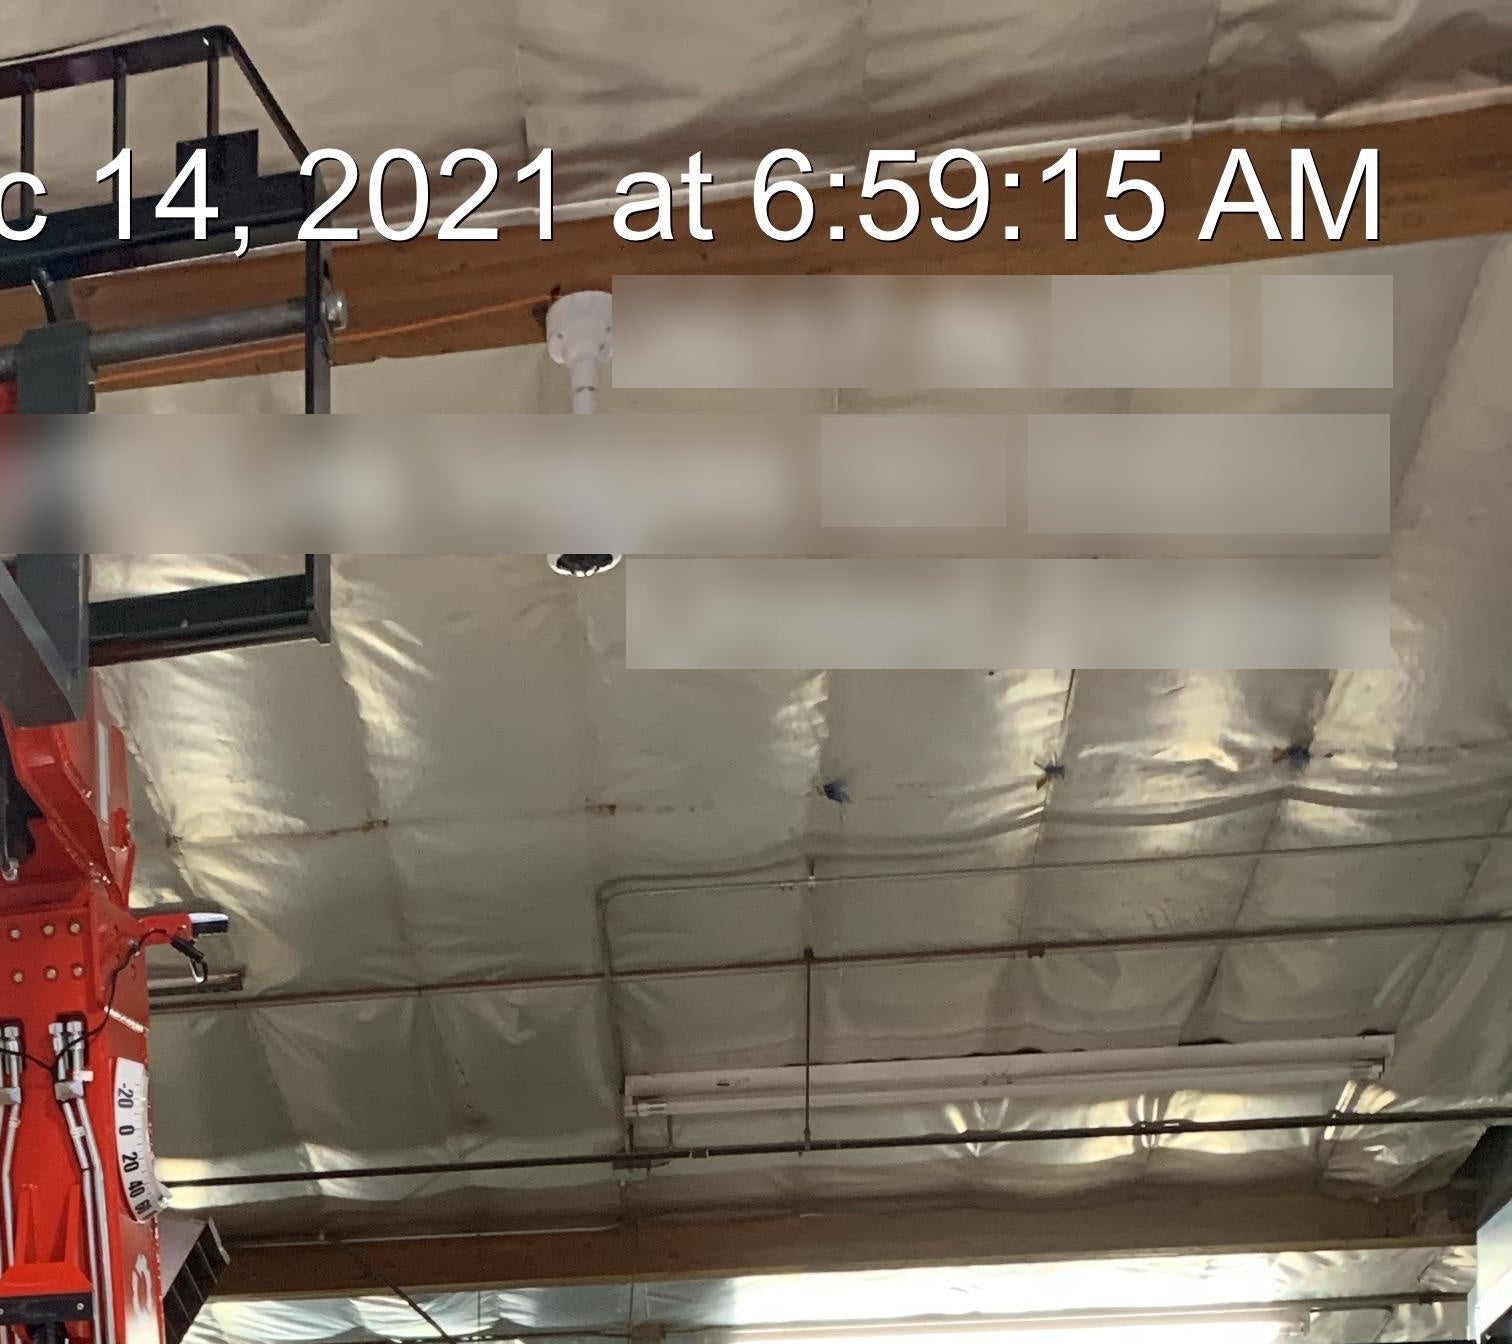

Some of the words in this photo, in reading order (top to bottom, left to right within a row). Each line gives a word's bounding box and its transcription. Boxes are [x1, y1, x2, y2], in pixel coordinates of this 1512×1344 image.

[118, 1125, 135, 1136] 0
[122, 1152, 139, 1173] 20
[128, 1180, 145, 1198] 40
